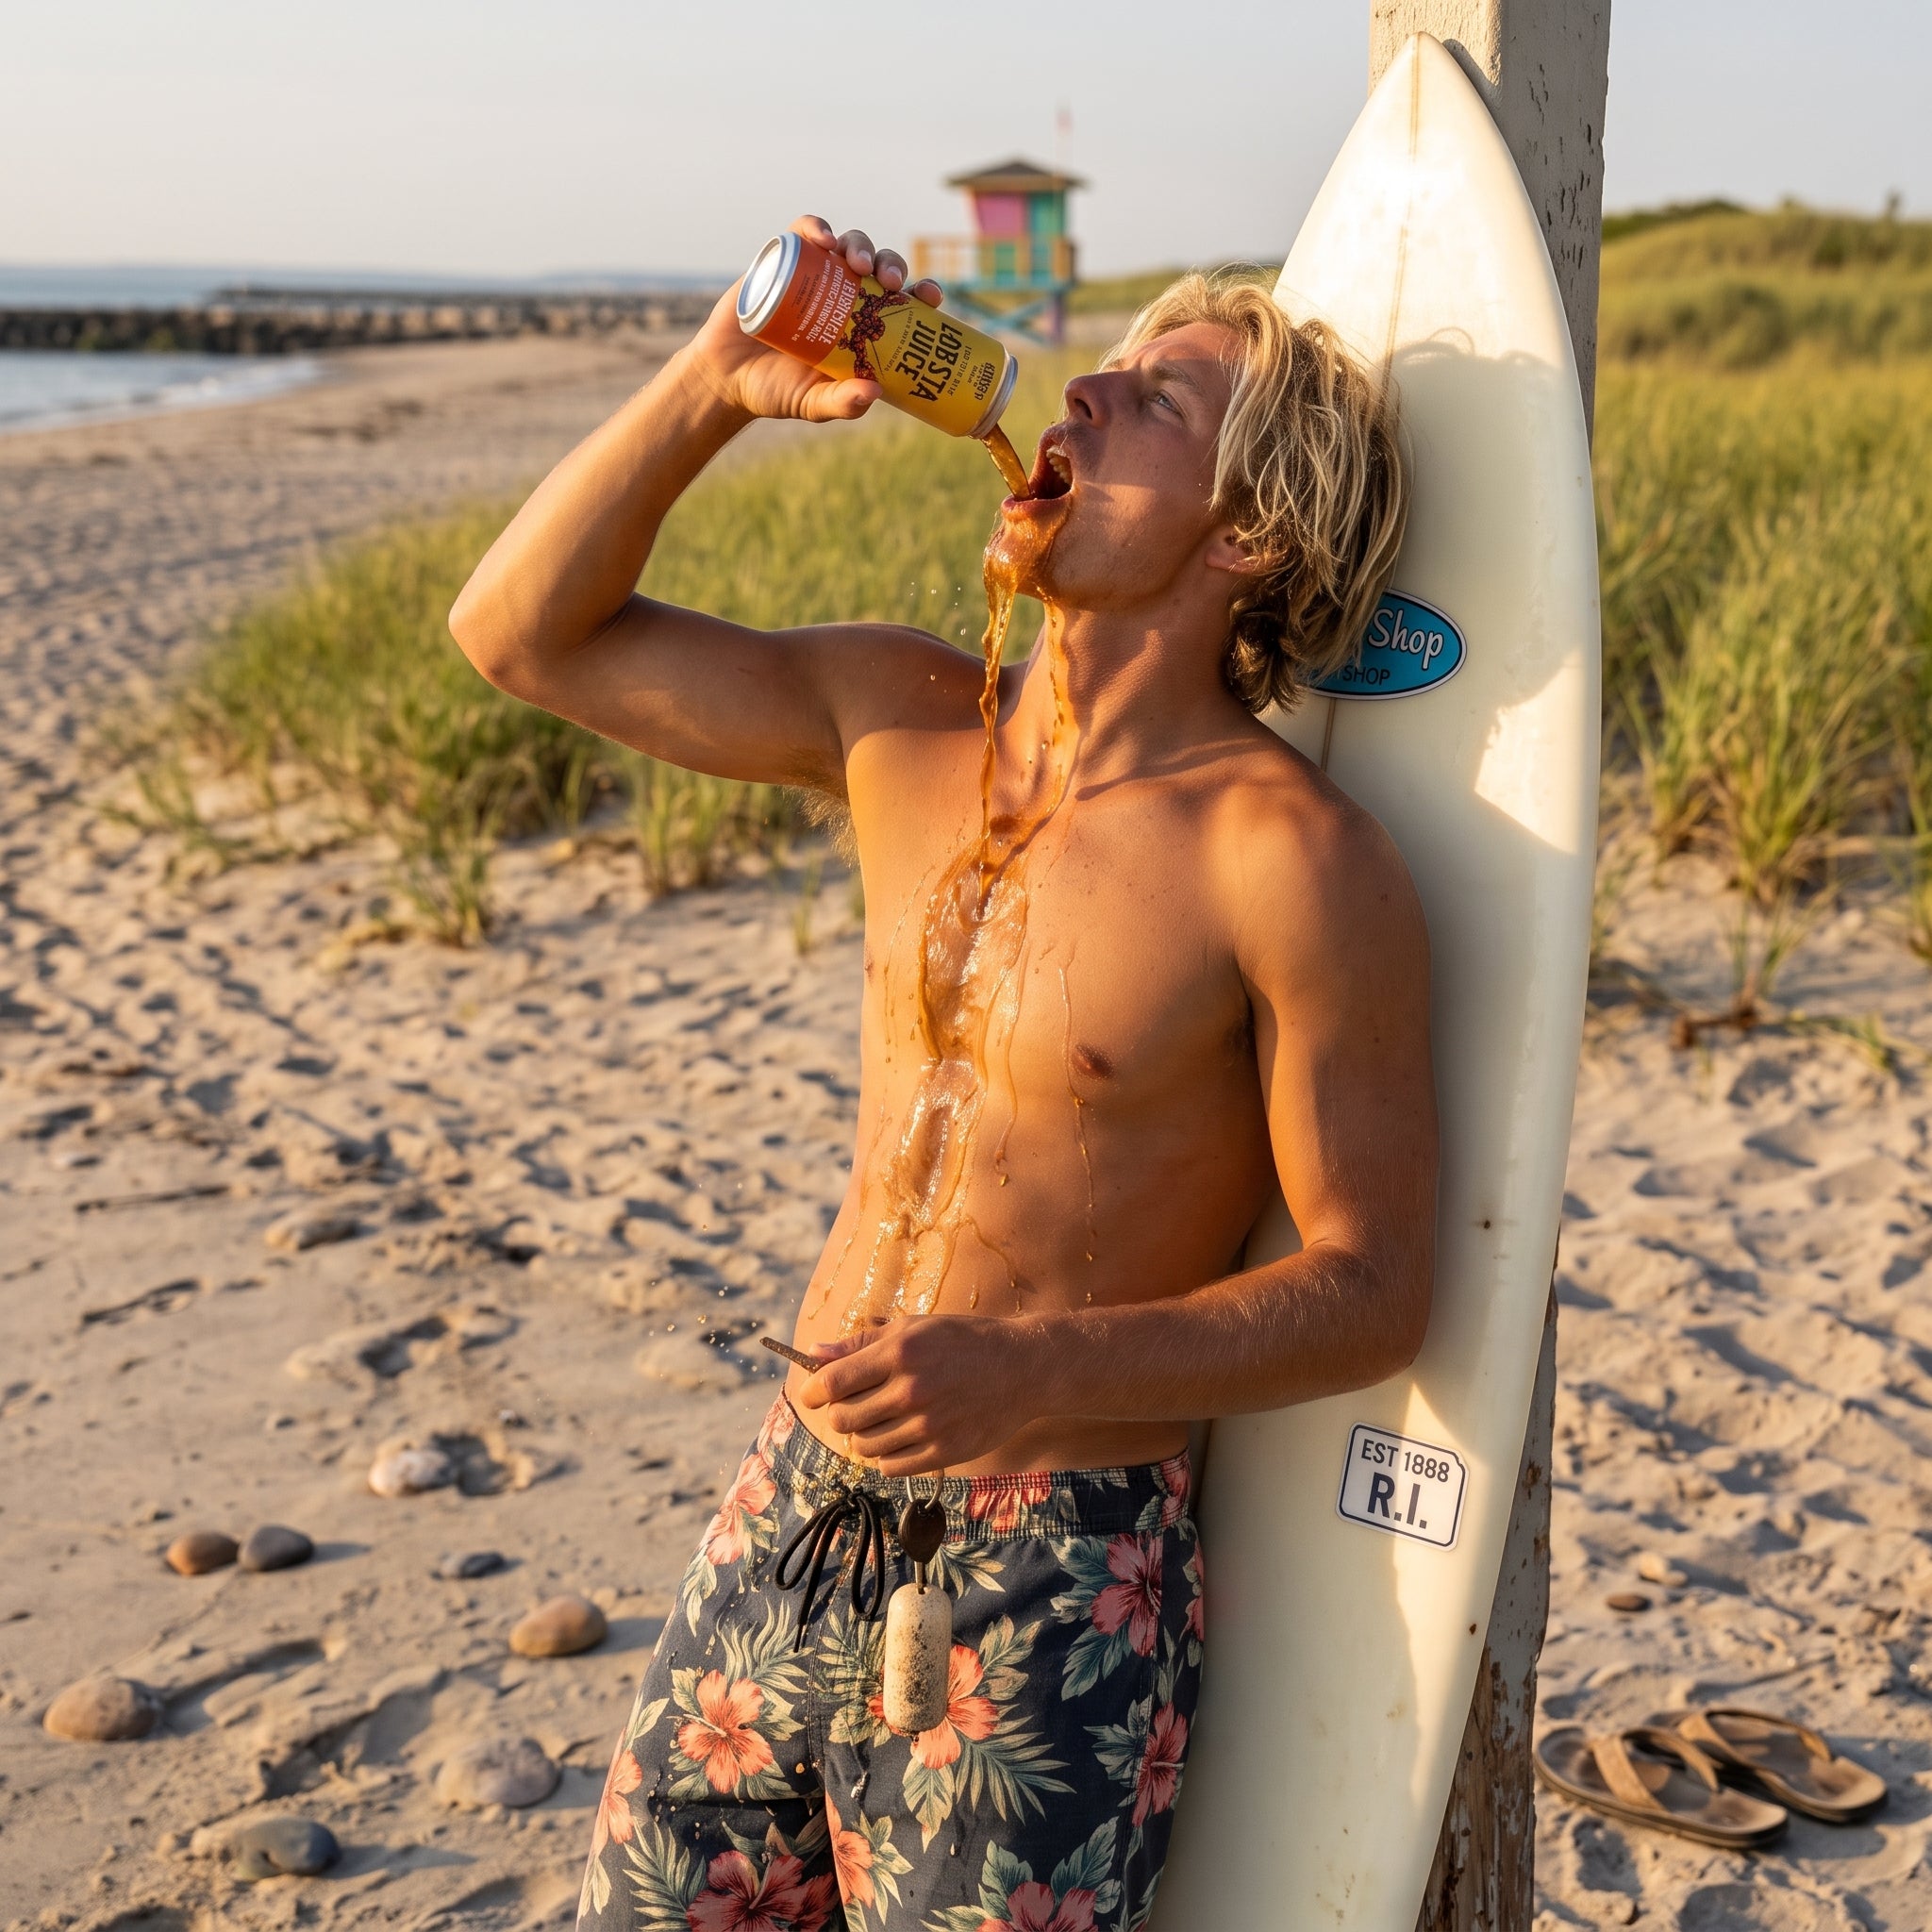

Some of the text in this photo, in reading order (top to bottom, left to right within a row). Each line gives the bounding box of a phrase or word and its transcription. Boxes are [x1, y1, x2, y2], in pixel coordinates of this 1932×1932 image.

[895, 320, 937, 381] JUICE
[909, 322, 963, 402] LOBSTA
[1367, 608, 1444, 671] Shop
[1342, 664, 1391, 685] SHOP
[1361, 1439, 1450, 1483] EST 1888
[1367, 1472, 1428, 1529] R.I.
